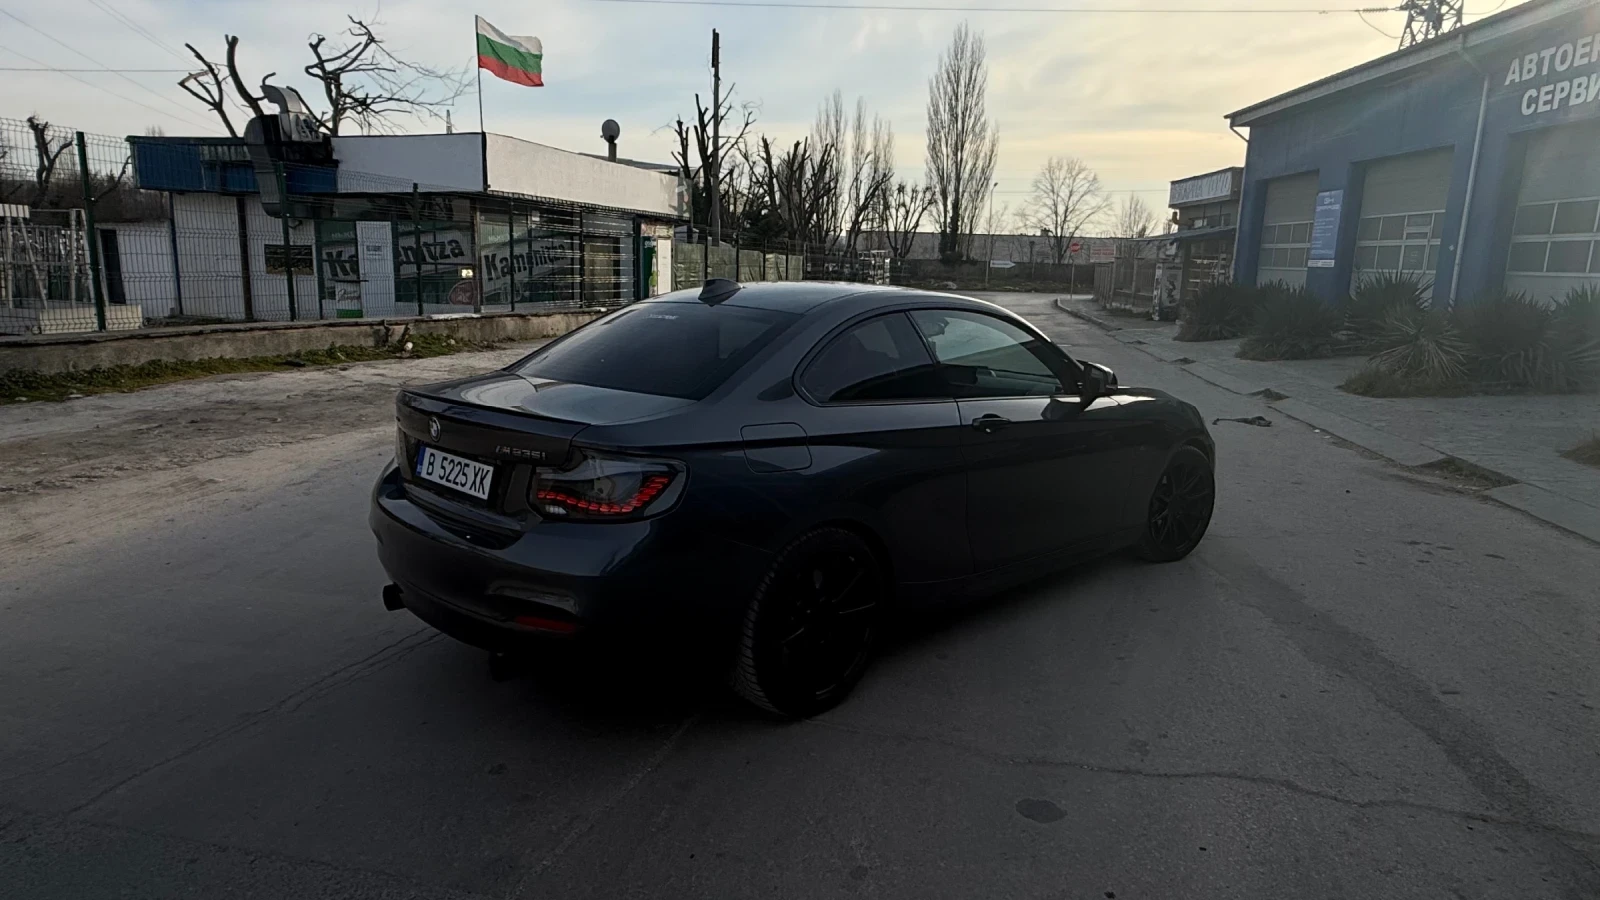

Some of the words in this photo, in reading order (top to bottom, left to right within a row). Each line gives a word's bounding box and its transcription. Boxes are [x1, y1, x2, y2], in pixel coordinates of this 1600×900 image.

[326, 238, 465, 277] Kantza
[426, 452, 436, 476] B
[438, 456, 470, 488] 5225
[469, 465, 490, 495] XK
